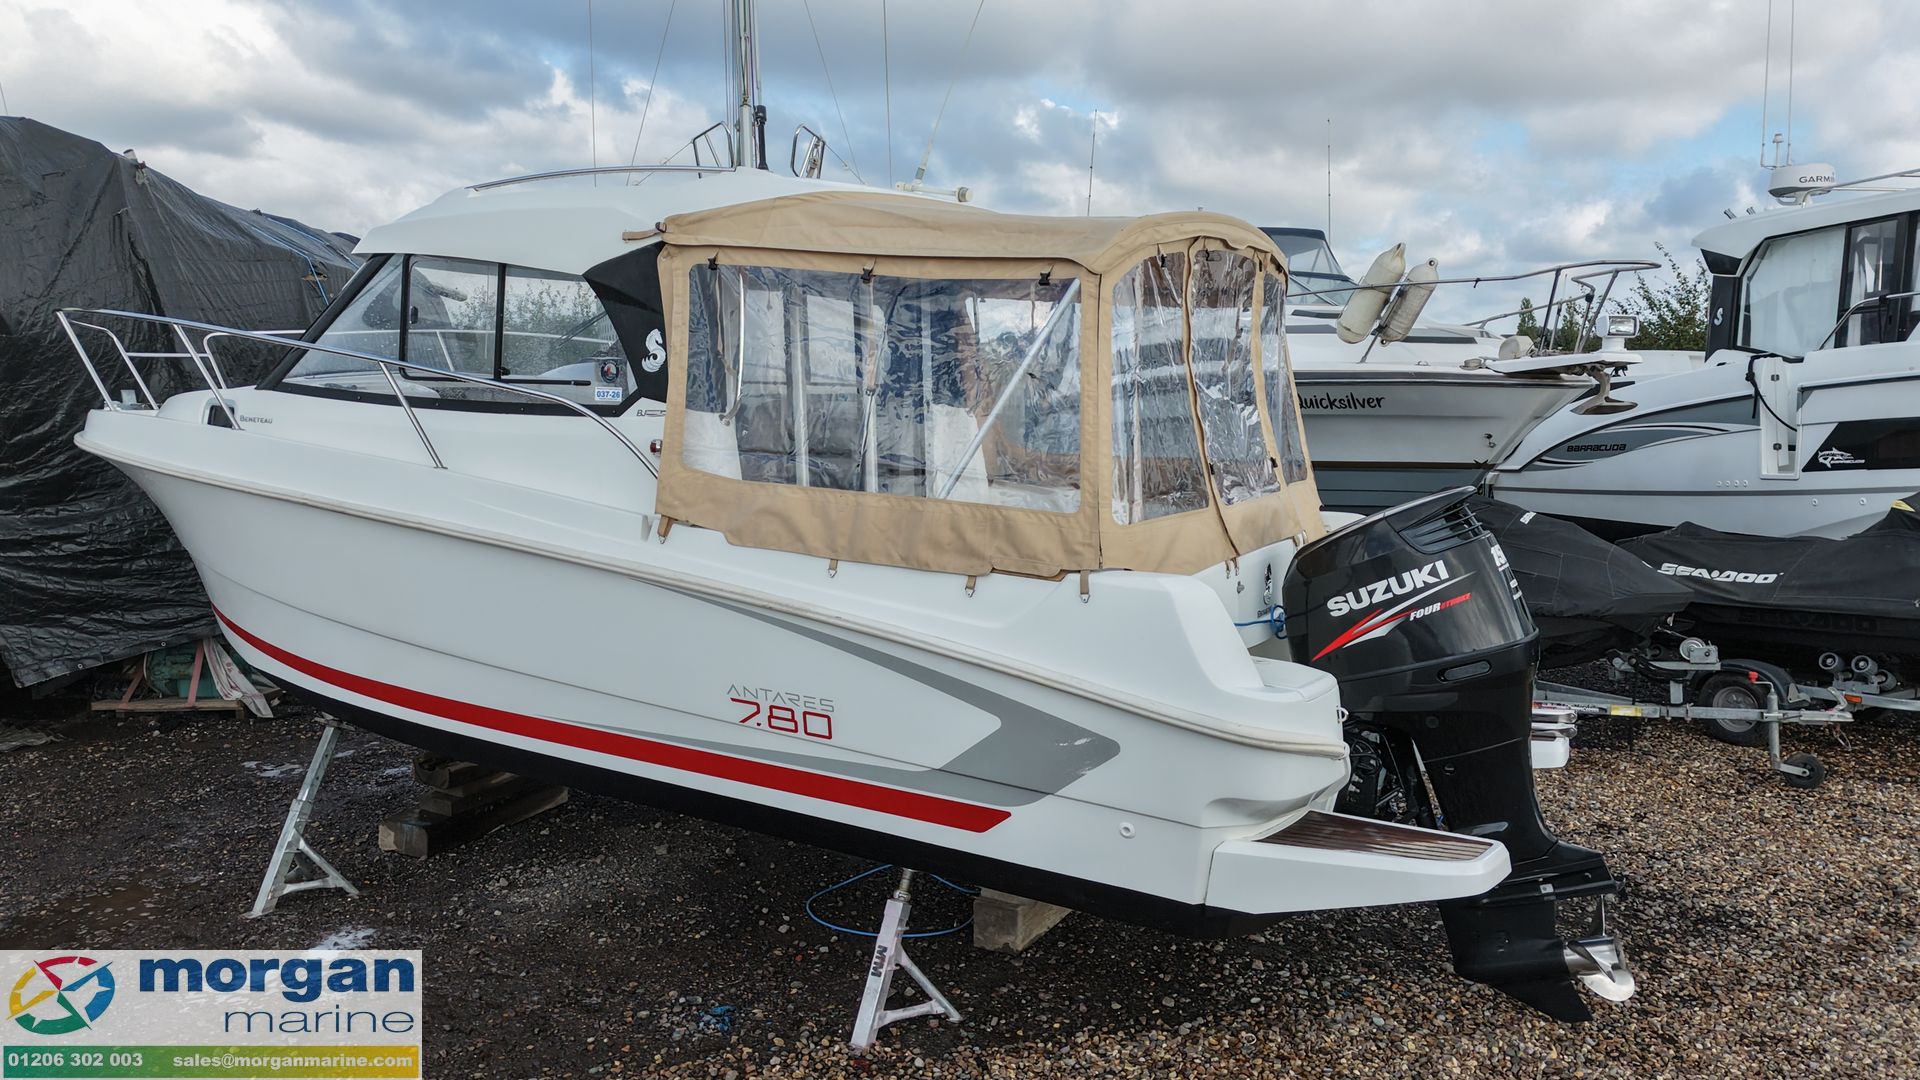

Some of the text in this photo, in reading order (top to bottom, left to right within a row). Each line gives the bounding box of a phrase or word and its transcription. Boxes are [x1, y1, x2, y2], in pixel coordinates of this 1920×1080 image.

[596, 390, 621, 399] 037-26
[1326, 560, 1450, 617] SUZUKI
[727, 684, 834, 712] ANTARES
[730, 697, 832, 740] 7.80
